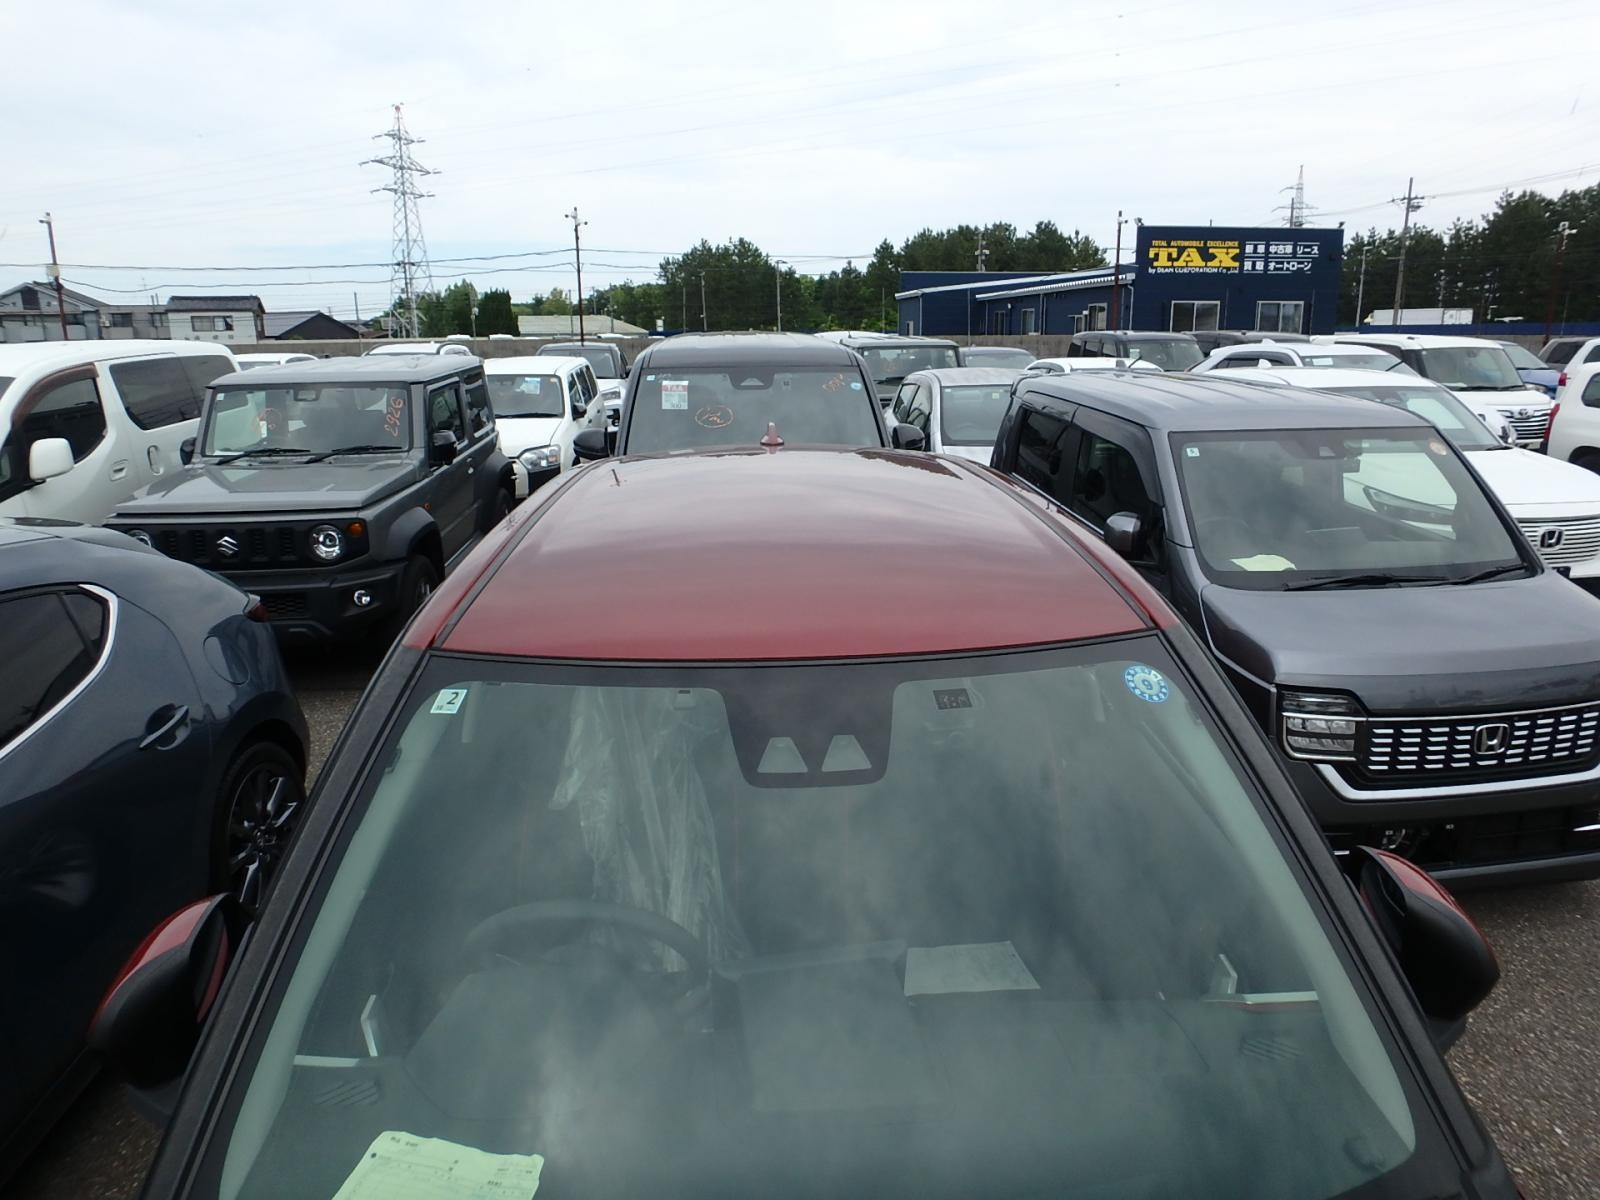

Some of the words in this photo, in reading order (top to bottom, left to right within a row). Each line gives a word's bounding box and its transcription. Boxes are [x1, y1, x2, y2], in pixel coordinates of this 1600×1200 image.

[1269, 244, 1293, 254] 中古車
[1296, 245, 1319, 255] リース
[1148, 247, 1240, 267] TAX
[1268, 261, 1312, 271] オートローン
[446, 691, 459, 705] 2
